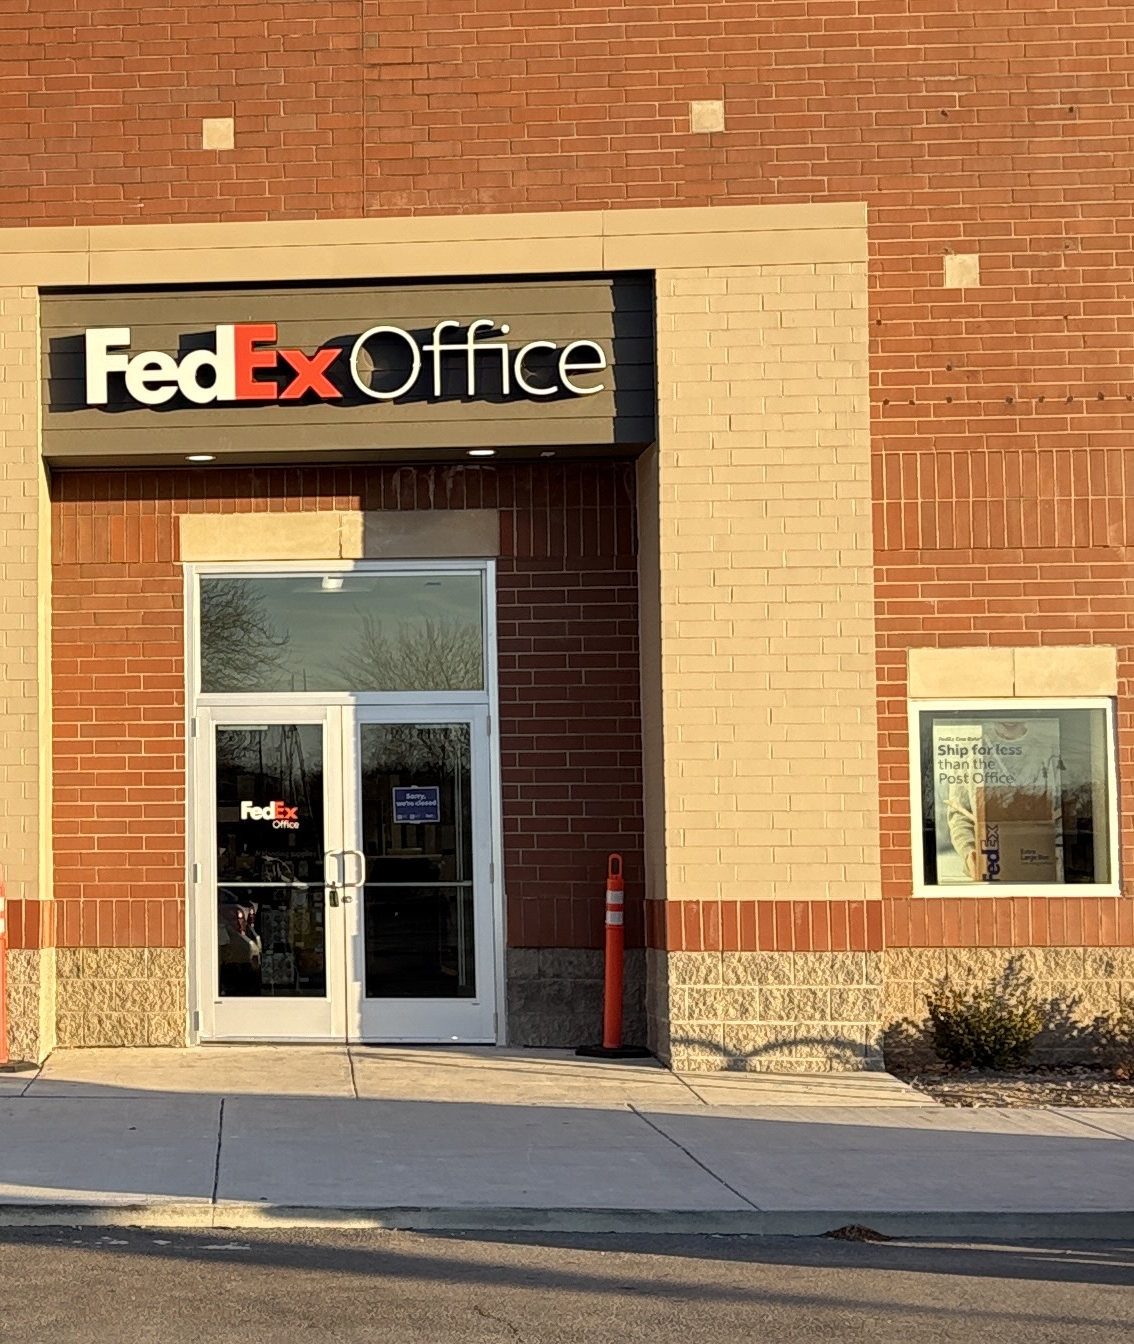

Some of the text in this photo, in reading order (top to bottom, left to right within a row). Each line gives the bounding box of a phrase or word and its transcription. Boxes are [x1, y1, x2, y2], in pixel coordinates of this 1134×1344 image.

[85, 319, 607, 406] FedEx Office
[938, 744, 1023, 758] Ship for less
[938, 759, 996, 770] than the
[939, 772, 1014, 784] Post Office
[240, 801, 299, 820] FedEx
[272, 820, 300, 829] Office
[981, 824, 1000, 881] FedEx
